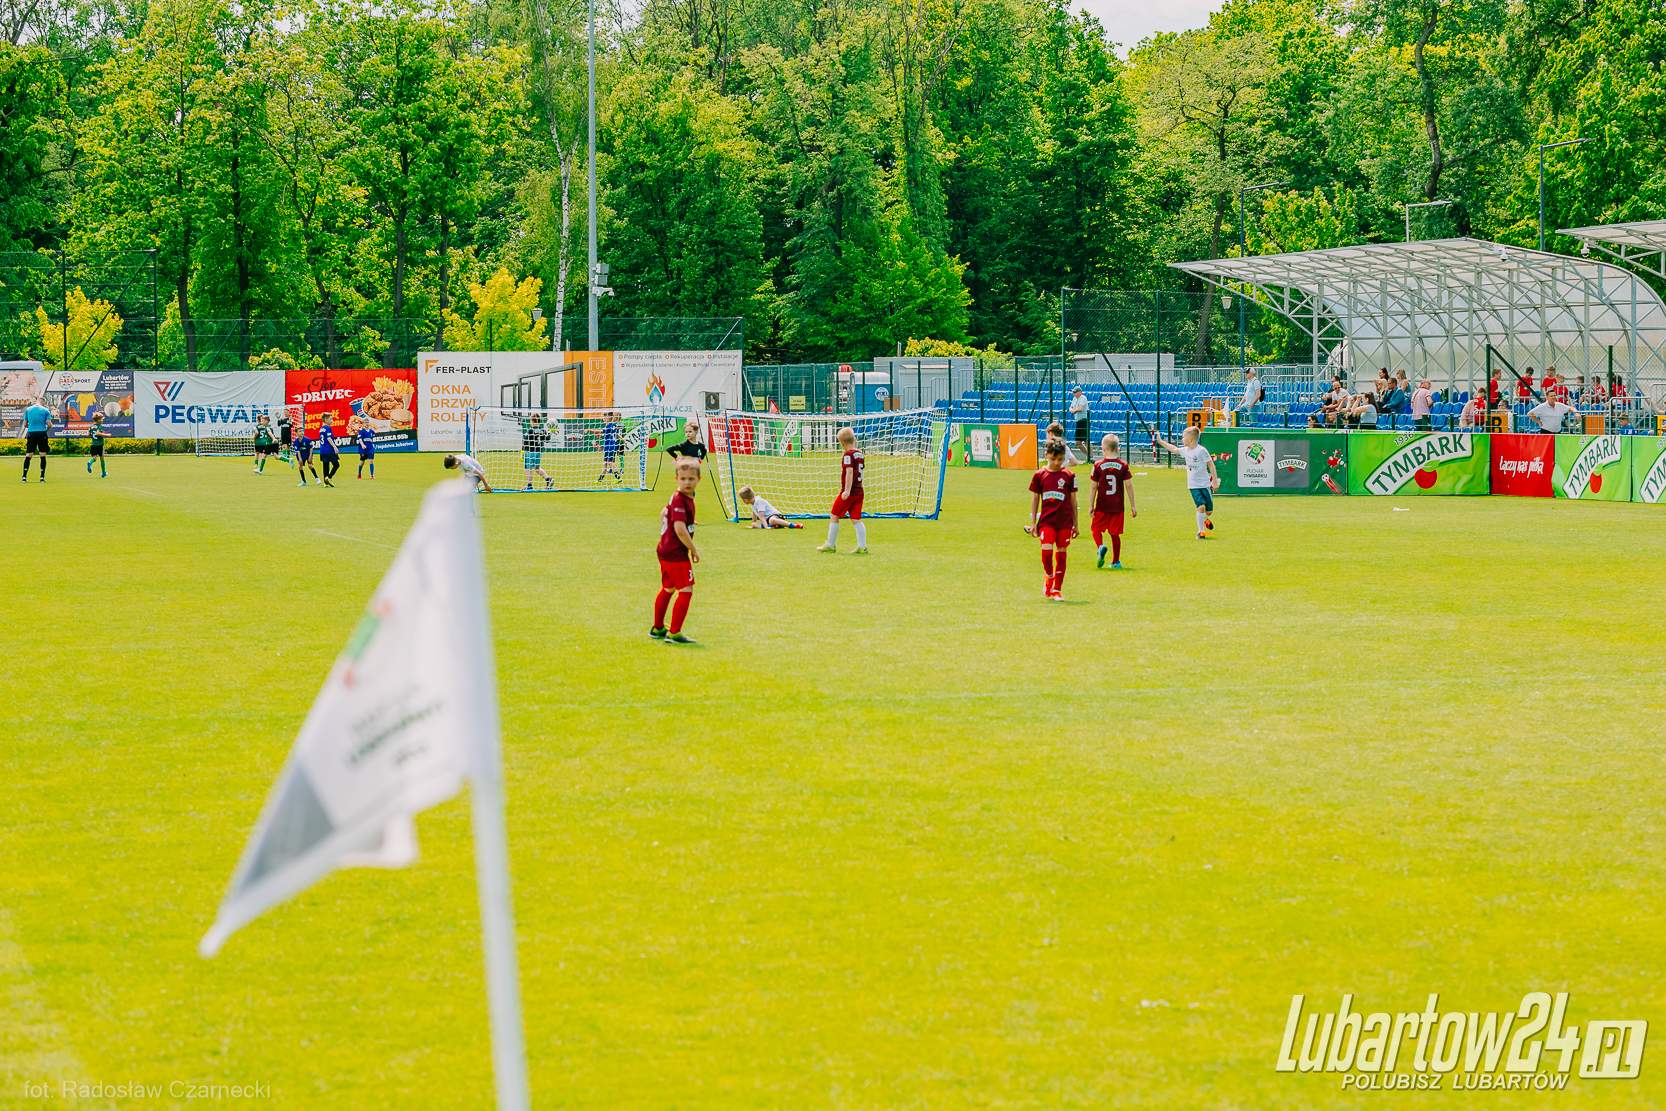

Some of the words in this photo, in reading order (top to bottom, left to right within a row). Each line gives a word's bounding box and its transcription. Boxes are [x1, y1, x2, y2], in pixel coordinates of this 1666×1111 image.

[435, 366, 492, 374] FER-PLAST
[302, 388, 345, 403] DRIVE
[430, 384, 472, 395] OKNA
[430, 398, 477, 409] DRZWI
[154, 404, 269, 424] PEGWAN
[211, 429, 257, 437] DRUKAR
[624, 418, 674, 450] YMARK
[1371, 433, 1467, 493] TYMBARK
[1568, 436, 1618, 496] TYMBARK
[1105, 474, 1117, 496] 3
